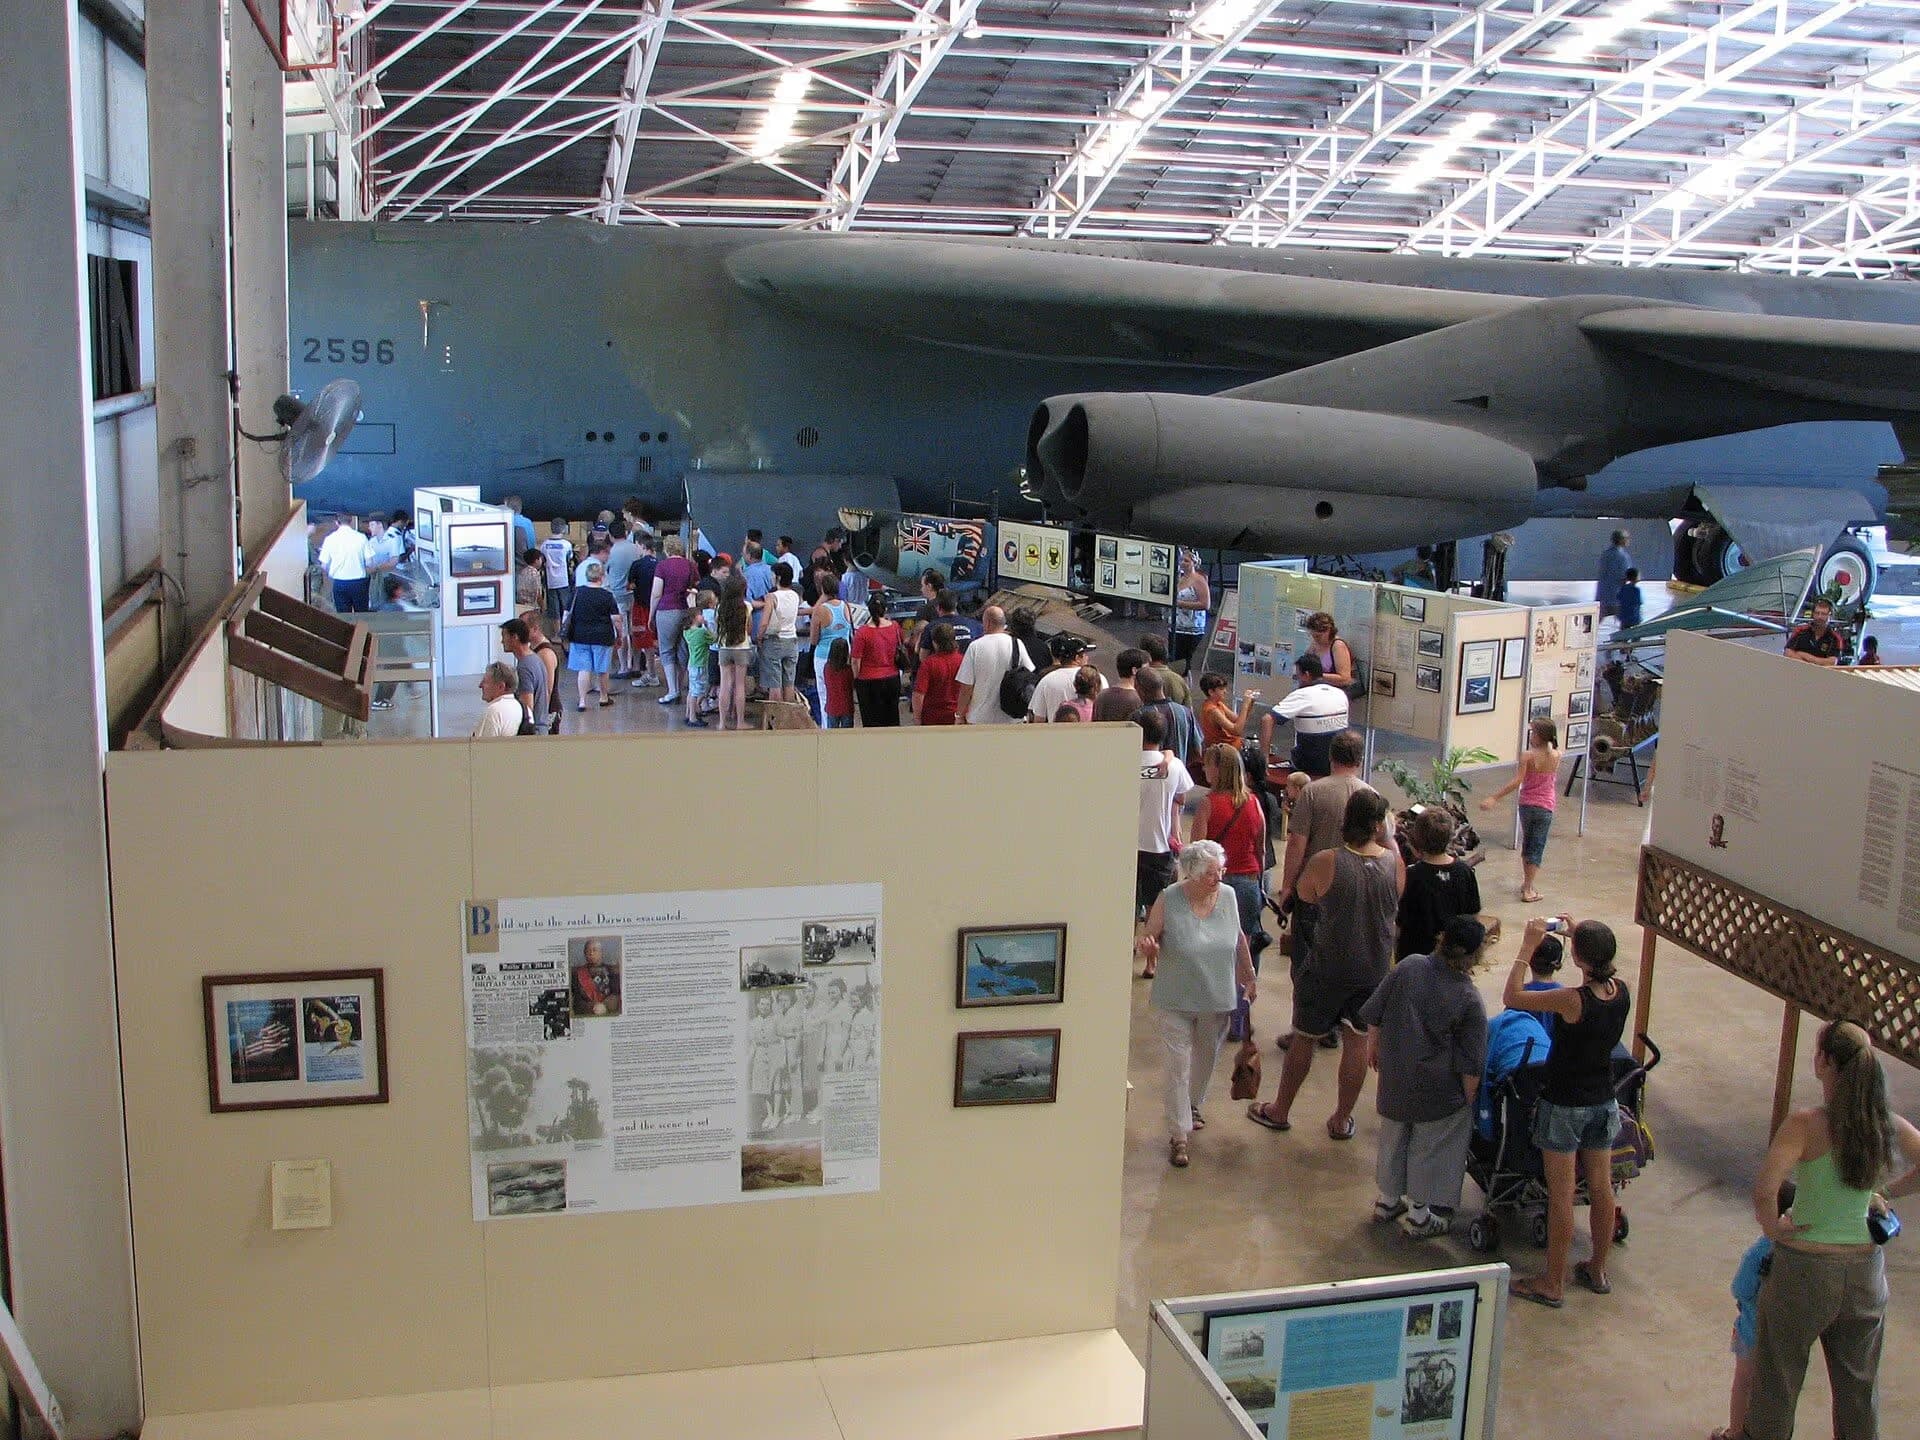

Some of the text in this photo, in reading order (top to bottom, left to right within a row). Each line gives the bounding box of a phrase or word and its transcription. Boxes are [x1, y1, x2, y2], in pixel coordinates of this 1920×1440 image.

[303, 337, 395, 365] 2596
[518, 921, 530, 930] up
[534, 919, 544, 927] to
[547, 915, 562, 926] the
[597, 912, 632, 925] Darwin
[640, 1119, 654, 1130] the
